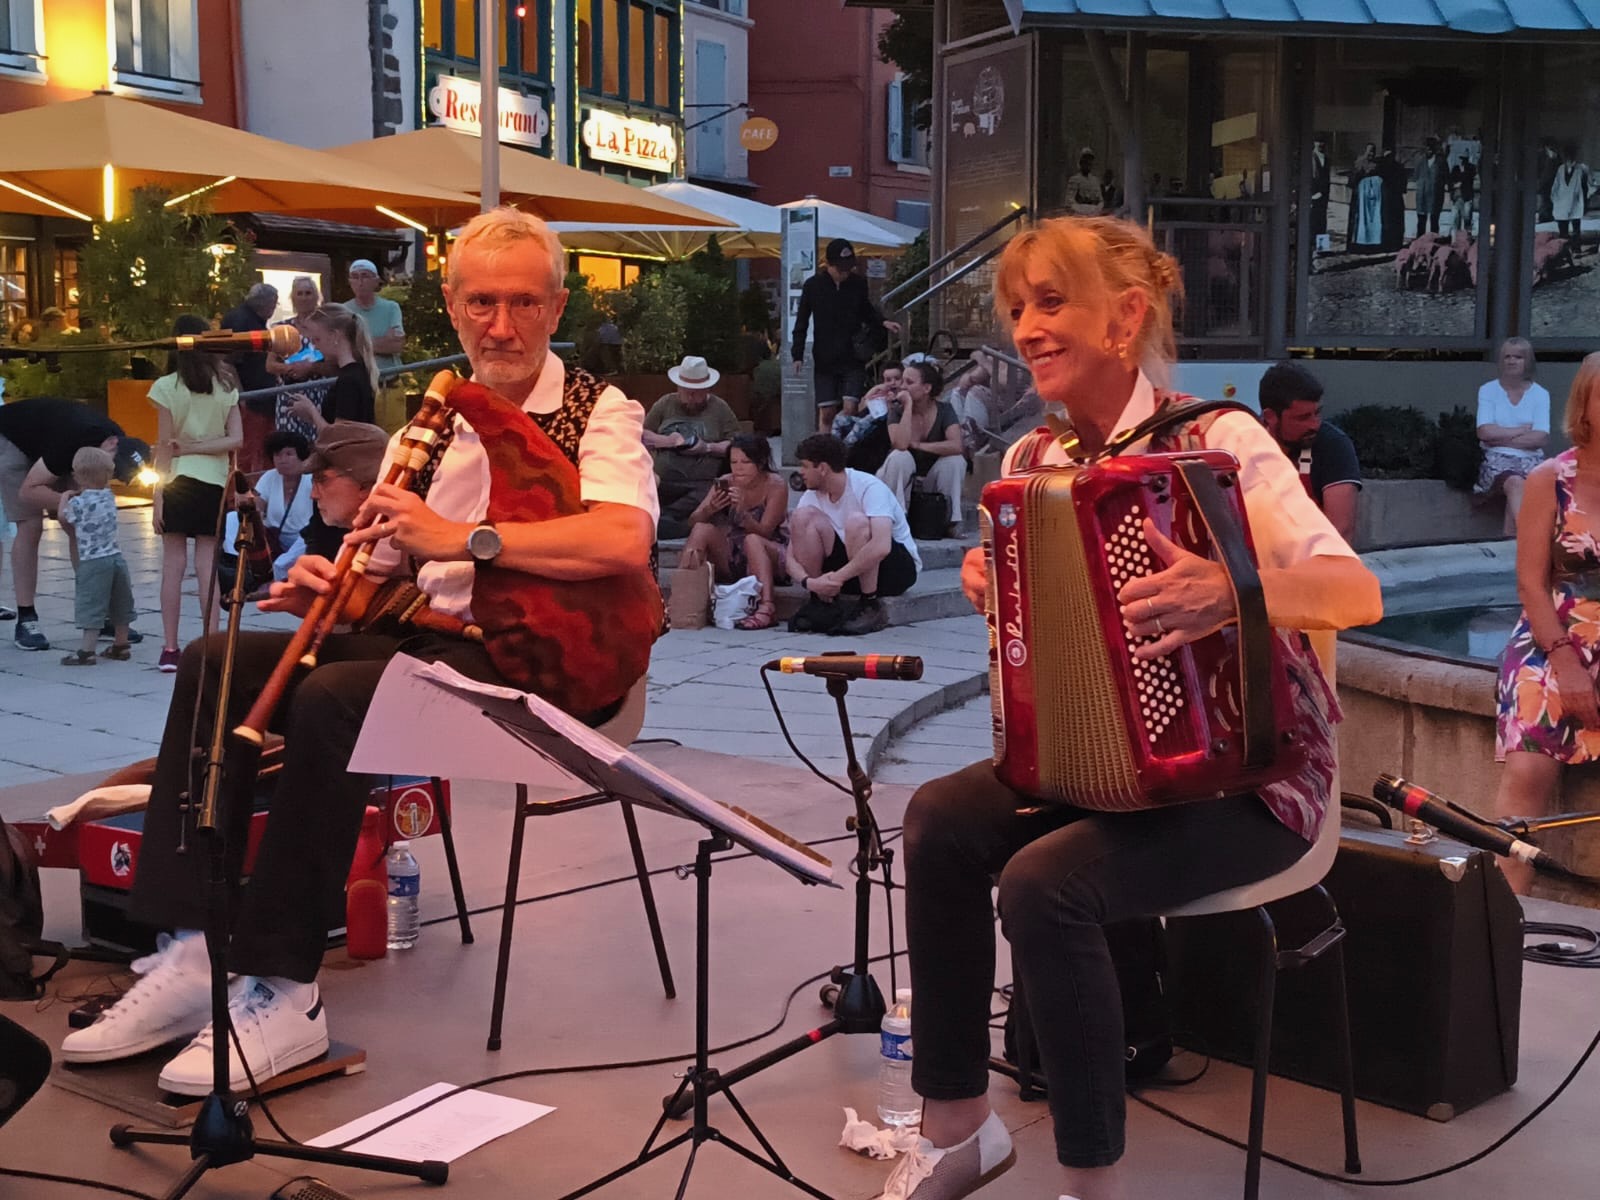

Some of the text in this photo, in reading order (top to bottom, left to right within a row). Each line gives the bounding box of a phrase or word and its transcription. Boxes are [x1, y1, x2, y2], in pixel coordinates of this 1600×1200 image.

[445, 88, 538, 134] Restrant
[596, 121, 669, 162] La Pizza
